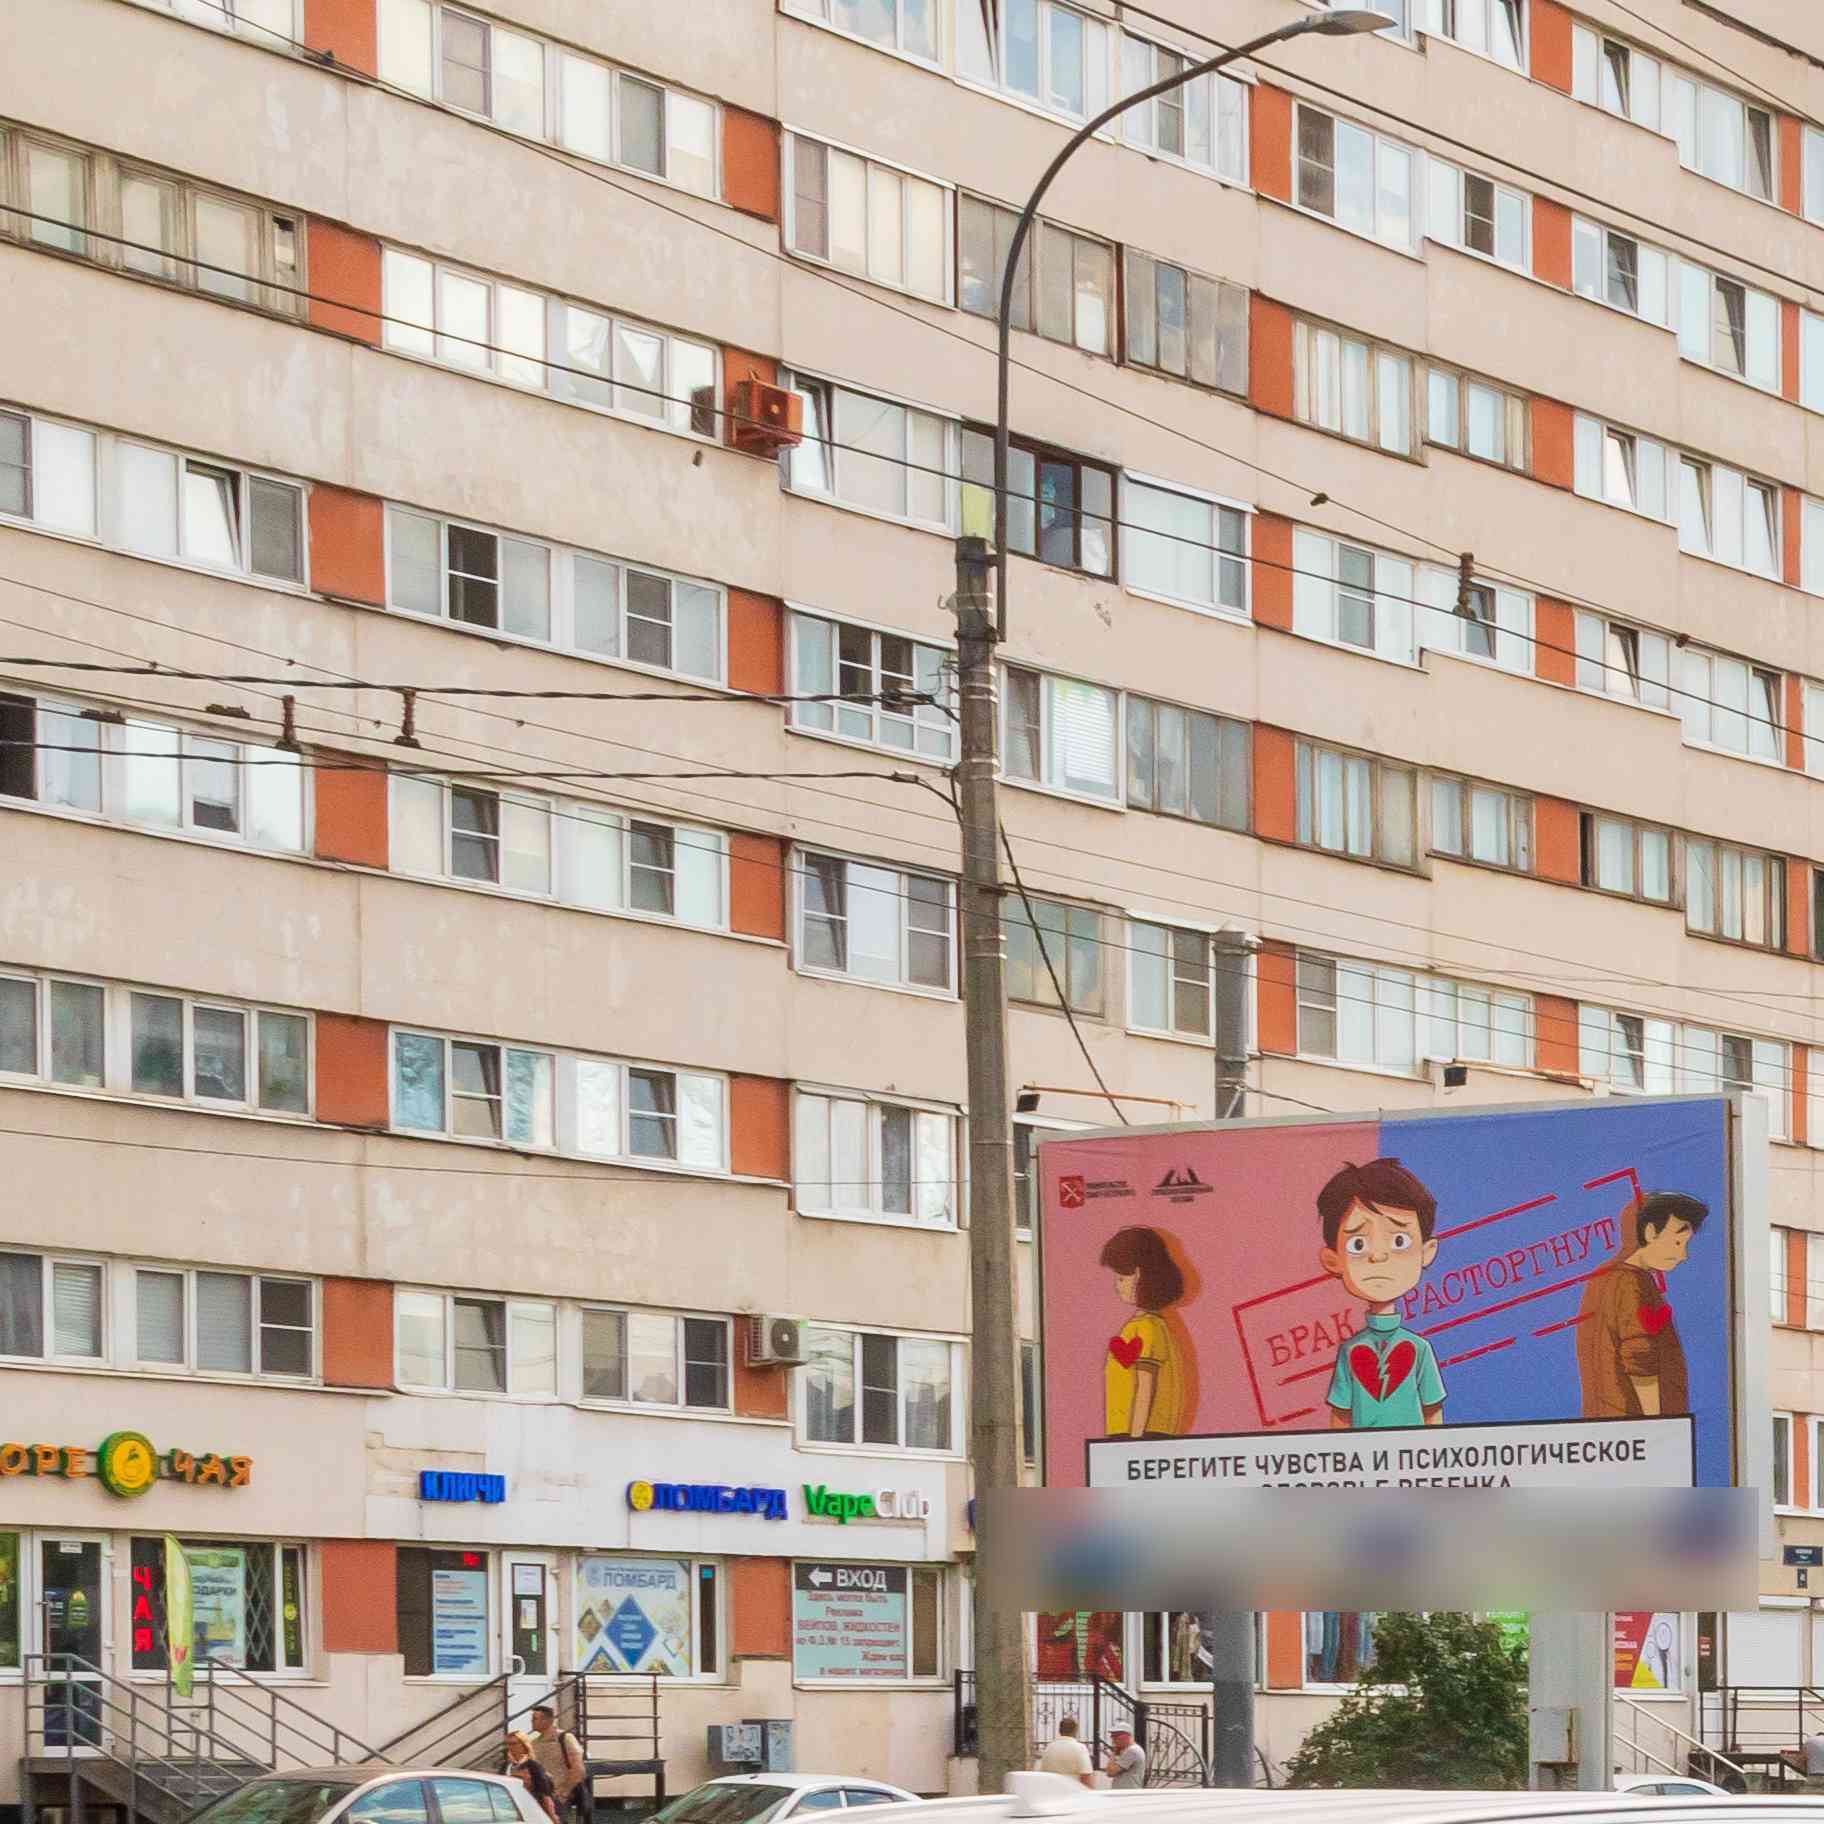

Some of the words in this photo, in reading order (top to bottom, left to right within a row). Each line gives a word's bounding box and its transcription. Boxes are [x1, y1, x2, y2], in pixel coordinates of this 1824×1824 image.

[1265, 1308, 1357, 1368] БРАК
[1401, 1217, 1617, 1321] РАСТОРГНУТ
[169, 1447, 253, 1489] ЧАЯ
[1126, 1455, 1247, 1481] БЕРЕГИТЕ
[1255, 1451, 1364, 1476] ЧУВСТВА
[1372, 1449, 1389, 1472] И
[1399, 1438, 1647, 1470] ПСИХОЛОГИЧЕСКОЕ
[420, 1470, 505, 1503] КЛЮЧИ
[652, 1482, 788, 1521] ЛОМБАРД
[603, 1572, 677, 1590] ЛОМБАРД
[835, 1568, 888, 1592] ВХОД
